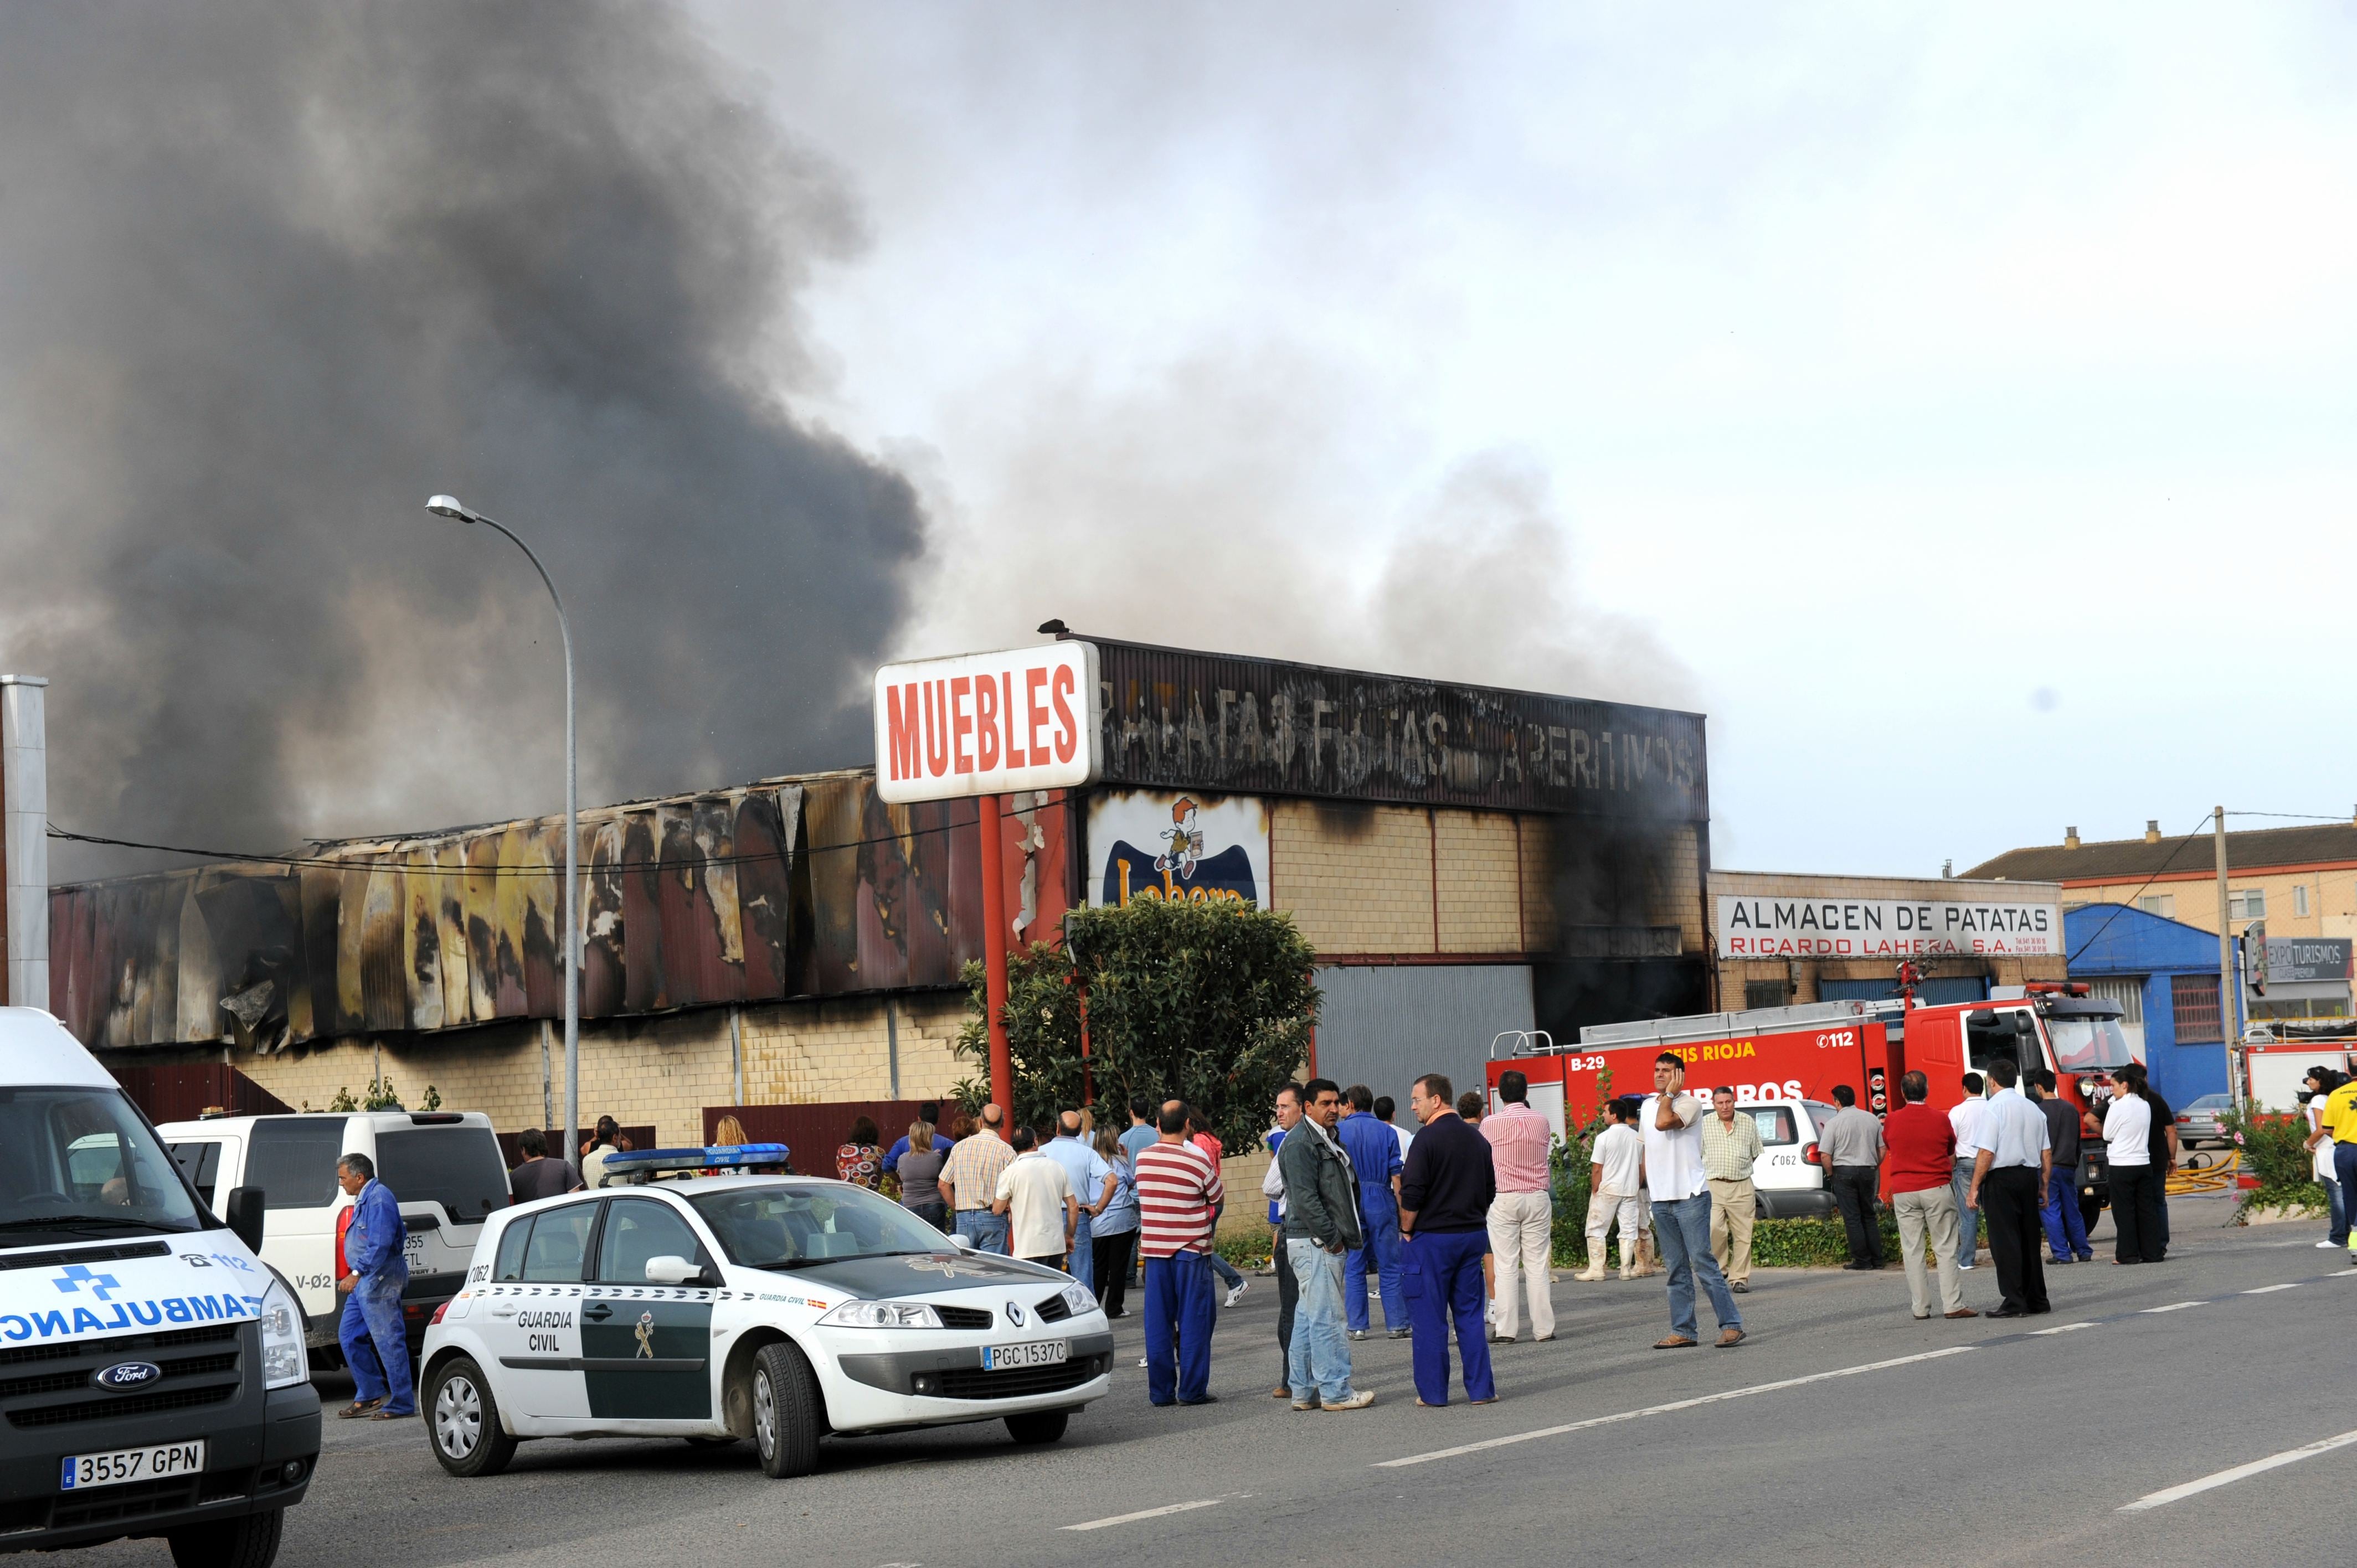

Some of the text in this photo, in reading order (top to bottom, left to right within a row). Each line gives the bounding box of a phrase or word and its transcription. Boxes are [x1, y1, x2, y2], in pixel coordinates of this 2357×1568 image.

[886, 664, 1077, 781] MUEBLES
[1731, 901, 2047, 932] ALMACEN DE PATATAS
[1731, 937, 1851, 954] RICARDO
[1973, 939, 2012, 953] S.A.
[1829, 1031, 1854, 1047] 112
[1703, 1041, 1756, 1061] RIOJA
[1571, 1055, 1605, 1072] B-29
[1780, 1155, 1796, 1165] 062
[403, 1235, 424, 1250] 355
[210, 1252, 255, 1273] 112
[473, 1265, 489, 1283] 062
[759, 1293, 805, 1305] GUARDIA CIVIL
[518, 1311, 572, 1329] GUARDIA
[529, 1334, 559, 1352] CIVIL
[993, 1347, 1021, 1366] PGC
[115, 1366, 148, 1382] Ford
[80, 1452, 143, 1483] 3557
[152, 1445, 198, 1473] GPN
